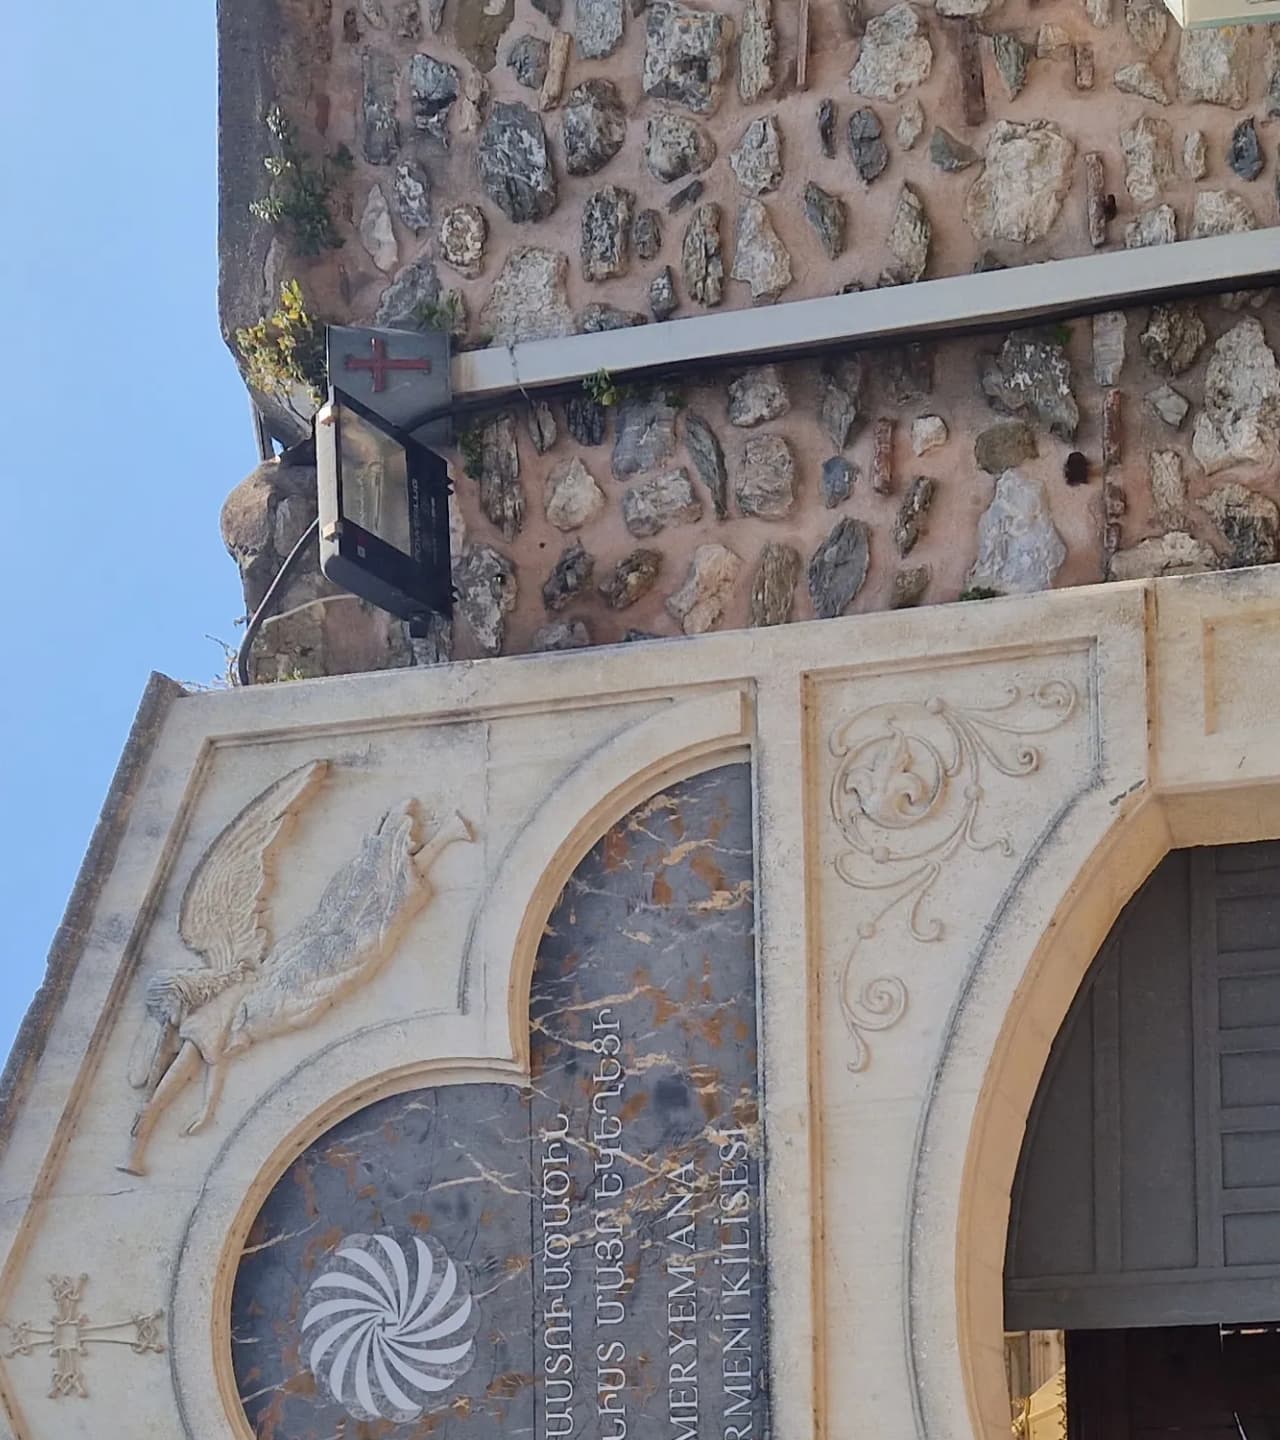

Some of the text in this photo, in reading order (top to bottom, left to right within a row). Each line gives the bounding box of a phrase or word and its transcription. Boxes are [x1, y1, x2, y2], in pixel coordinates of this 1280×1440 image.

[591, 1008, 625, 1200] ԵԿԵՂԵՑԻ
[540, 1113, 573, 1439] ԱՍՏՈՒԱԾԱԾԻՆ
[593, 1209, 625, 1327] ՄԱՅՐ
[665, 1160, 696, 1251] ANA
[711, 1126, 751, 1298] KİLİSESİ
